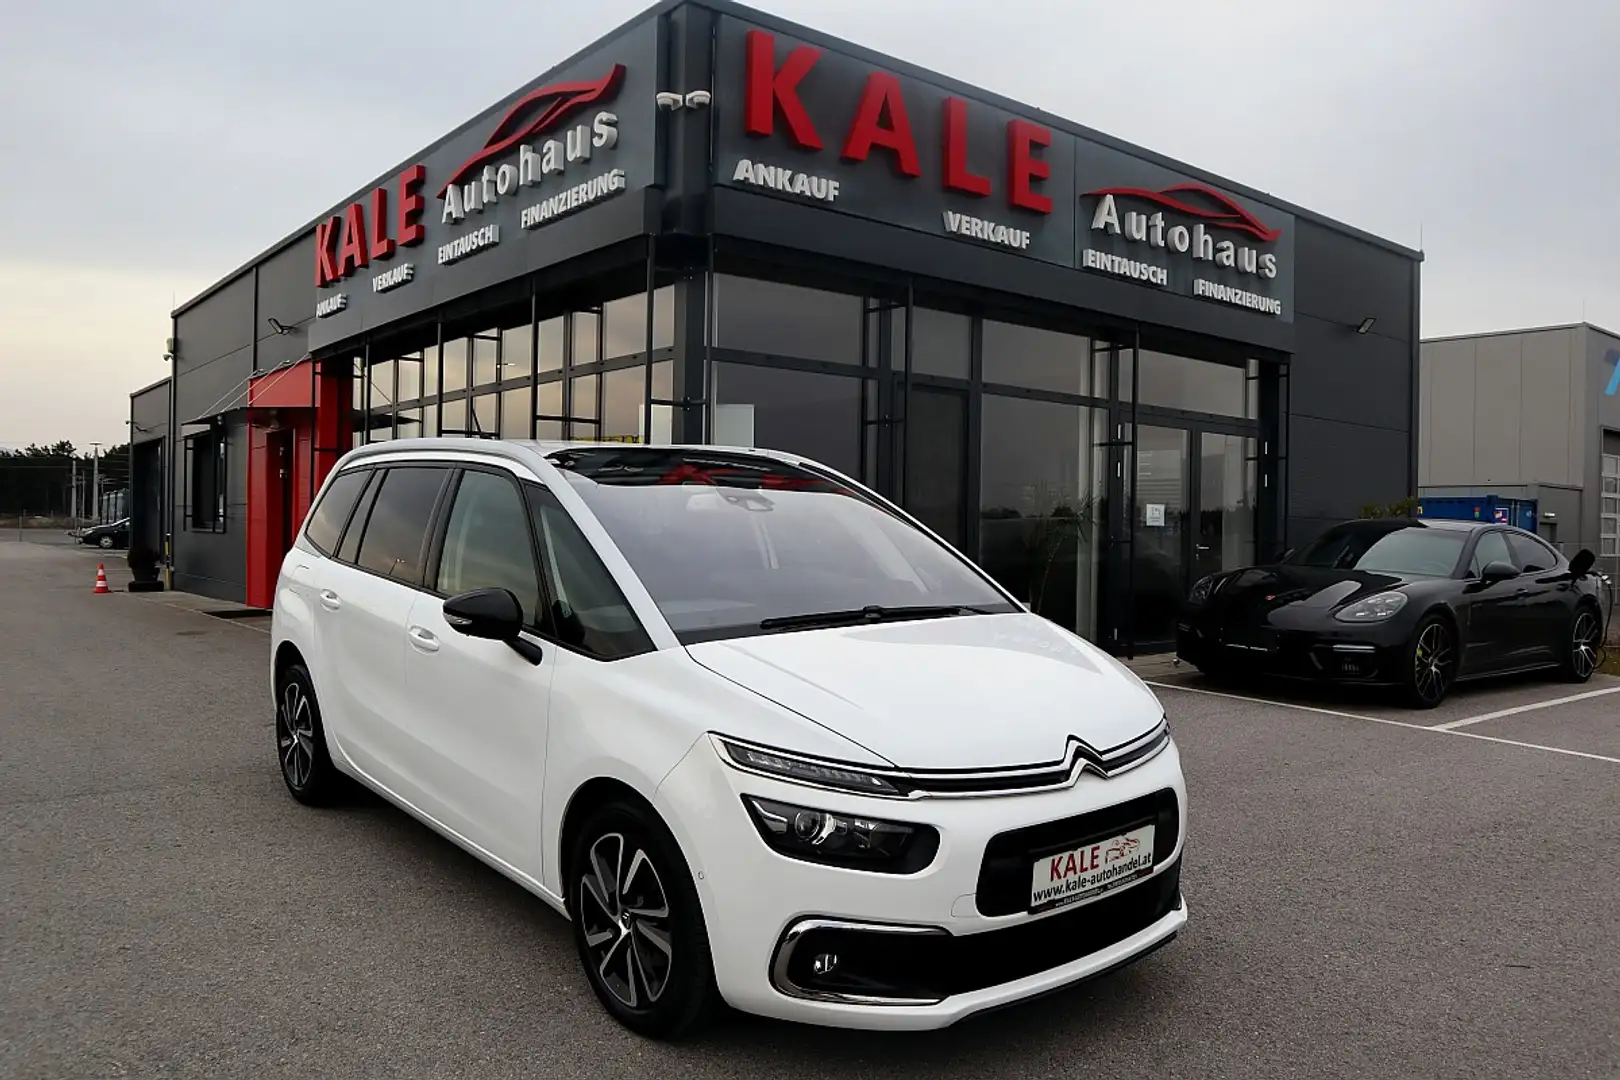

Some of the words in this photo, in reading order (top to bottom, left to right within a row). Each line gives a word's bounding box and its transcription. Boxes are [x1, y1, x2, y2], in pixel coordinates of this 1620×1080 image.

[745, 29, 1053, 215] KALE
[441, 111, 619, 224] Autohaus
[733, 159, 840, 202] ANKAUF
[521, 168, 626, 230] FINANZIERUNG
[314, 164, 426, 288] KALE
[438, 224, 500, 265] EINTAUSCH
[943, 211, 1031, 249] VERKAUF
[1091, 194, 1278, 279] Autohaus
[372, 262, 415, 293] VERKAUF
[1082, 248, 1168, 286] EINTAUSCH
[1193, 278, 1282, 316] FINANZIERUNG
[1032, 851, 1152, 903] www.kale-autohandel.at
[1049, 844, 1101, 883] KALE
